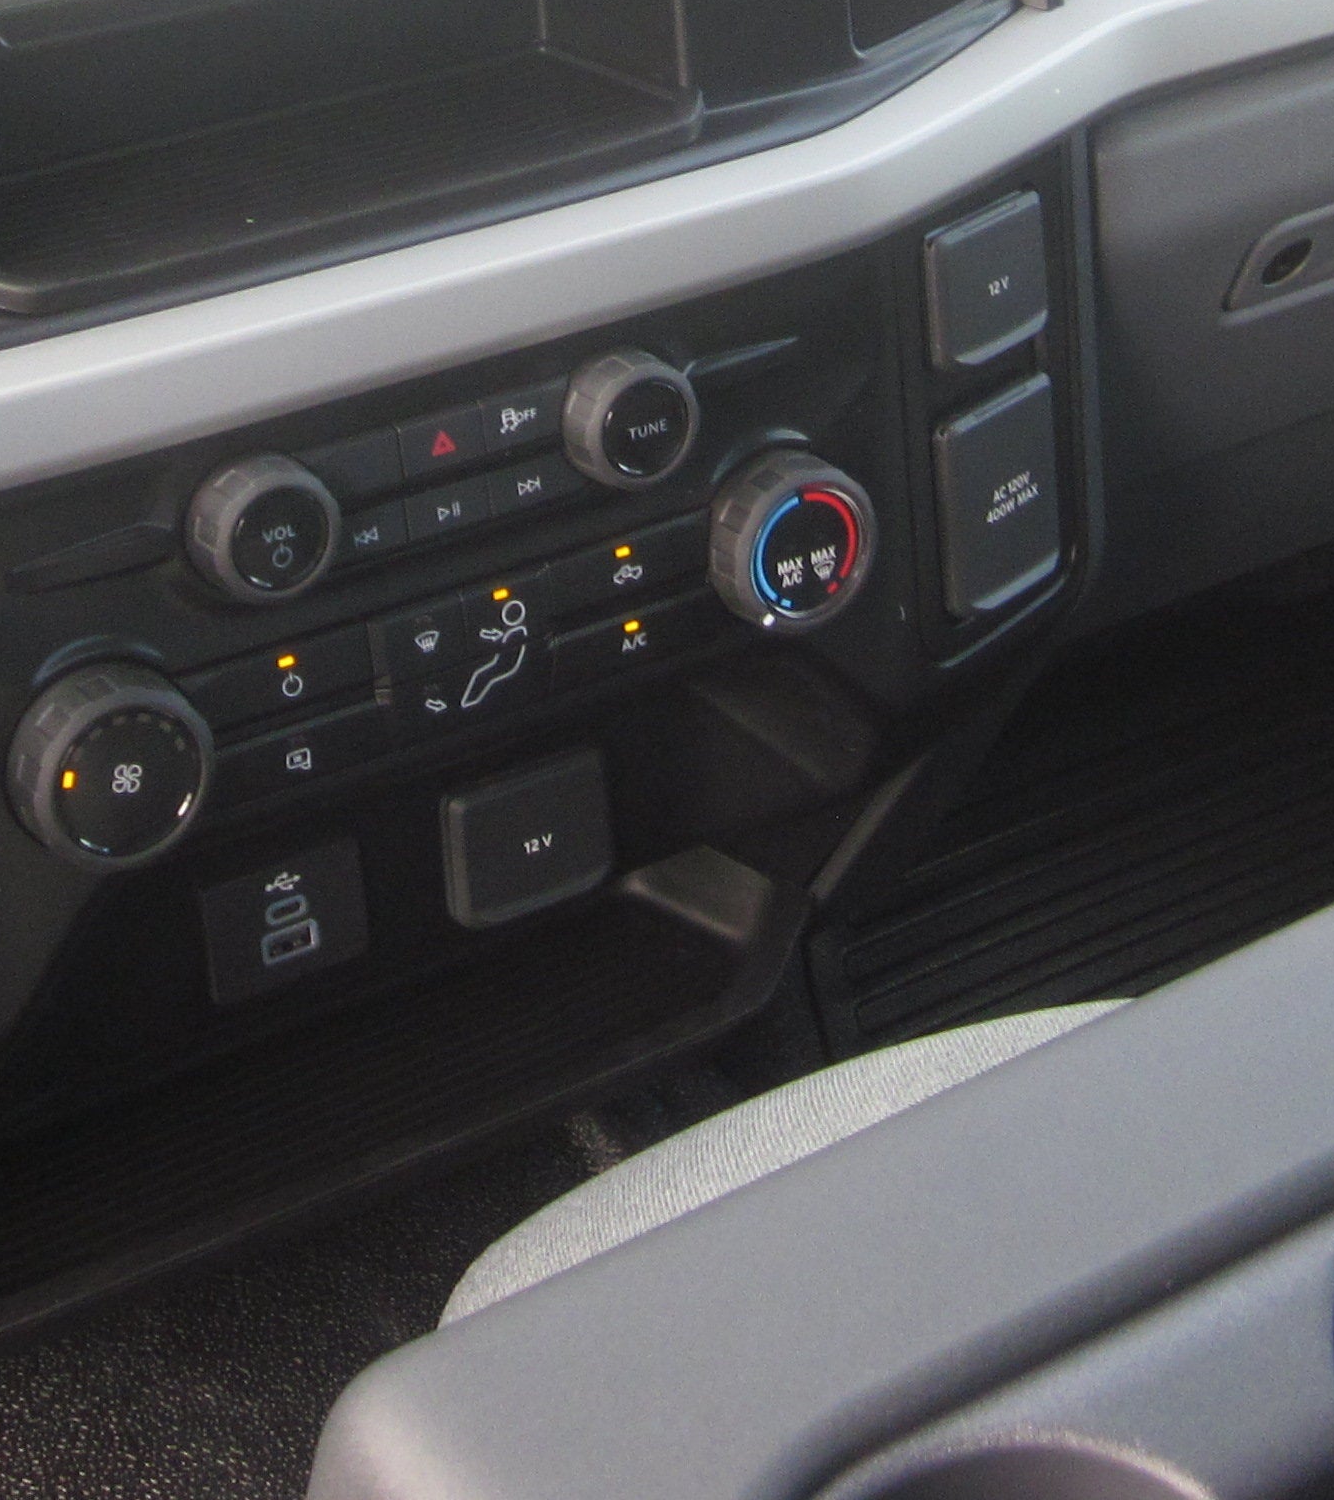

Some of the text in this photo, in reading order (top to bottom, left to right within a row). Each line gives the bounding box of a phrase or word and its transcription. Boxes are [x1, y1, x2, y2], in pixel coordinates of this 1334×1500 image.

[516, 407, 538, 423] OFF
[628, 418, 668, 440] TUNE
[262, 525, 296, 543] VOL
[810, 545, 837, 565] MAX
[776, 556, 804, 577] MAX
[781, 570, 803, 588] A/C
[622, 631, 648, 653] A/C
